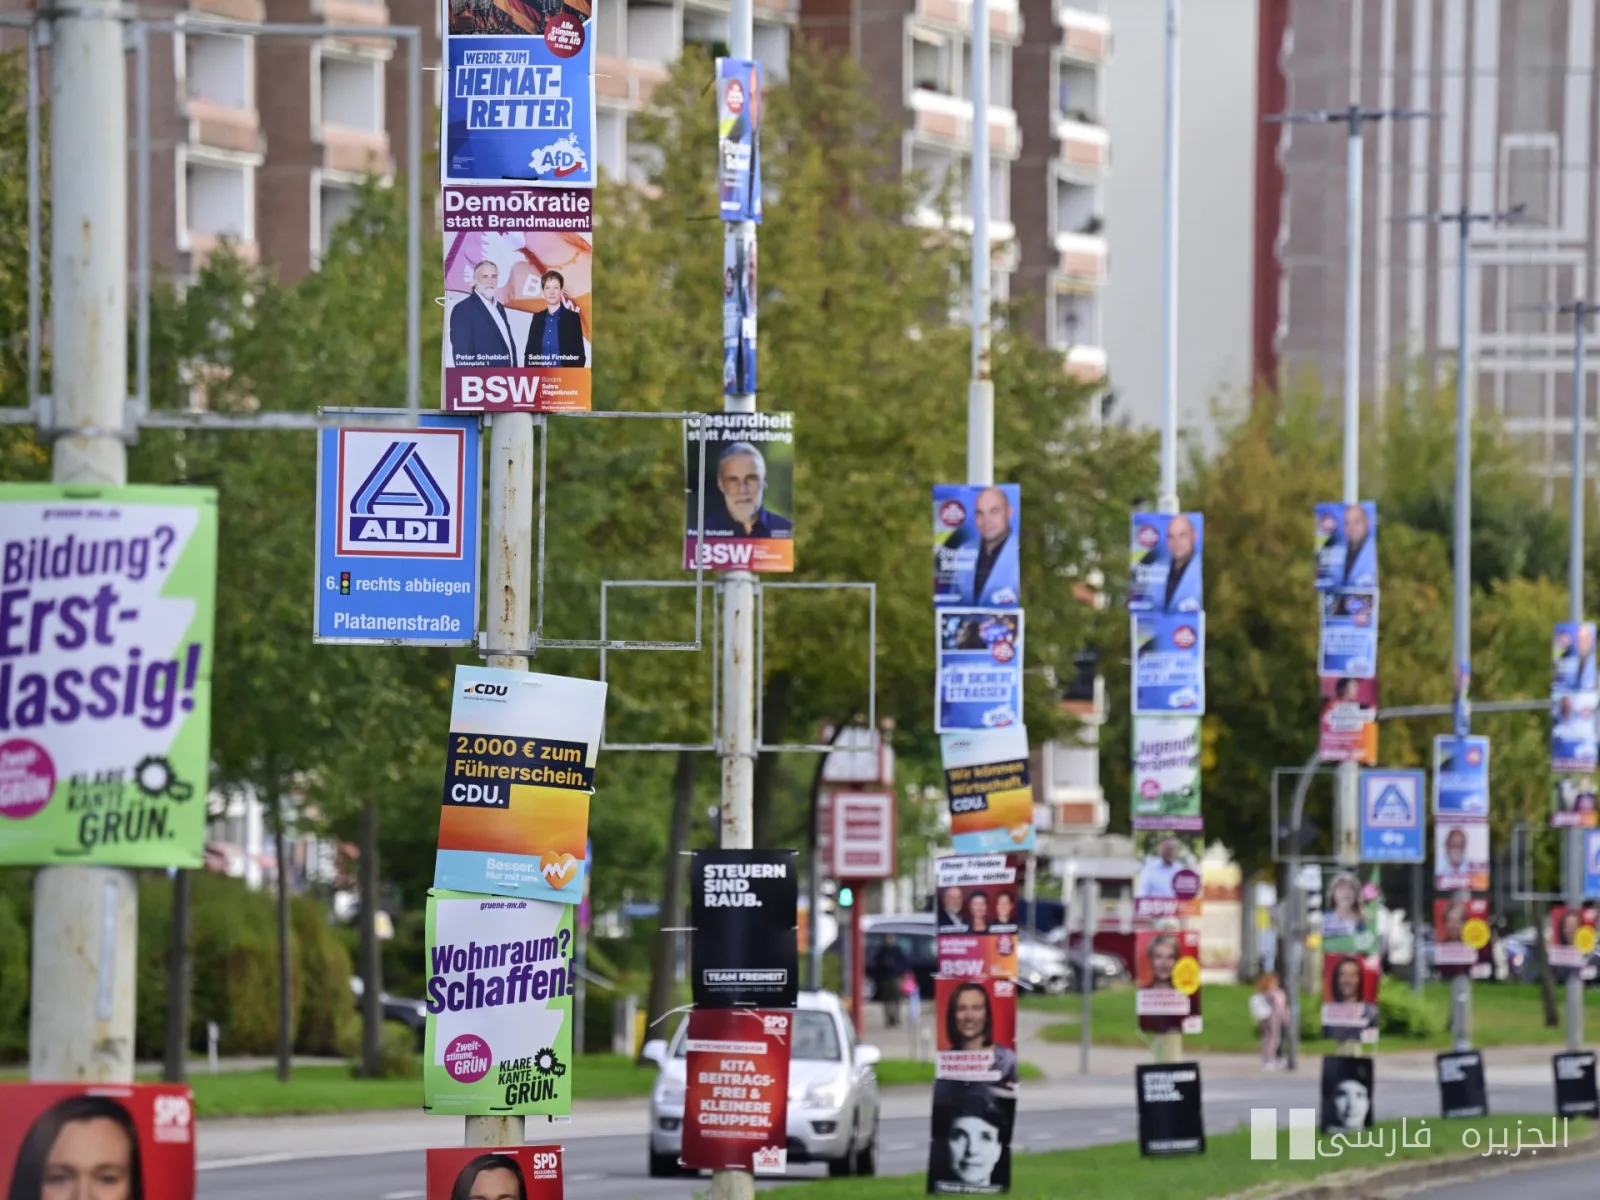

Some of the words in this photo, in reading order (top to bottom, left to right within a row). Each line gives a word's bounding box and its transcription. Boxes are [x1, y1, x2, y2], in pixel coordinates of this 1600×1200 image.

[551, 27, 579, 37] Stimmen
[561, 21, 573, 30] Alle
[558, 35, 569, 43] die
[465, 52, 503, 64] WERDE
[505, 52, 528, 64] ZUM
[456, 67, 561, 96] HEIMAT-
[469, 99, 571, 127] RETTER
[541, 151, 574, 167] AfD
[445, 191, 590, 212] Demokratie
[446, 215, 483, 228] statt
[488, 215, 590, 228] Brandmauern!
[461, 375, 540, 404] BSW
[688, 429, 719, 441] sttt
[722, 429, 793, 444] Aufrüstung
[358, 519, 438, 541] ALDI
[2, 525, 176, 586] Bildung?
[325, 575, 339, 590] 6.
[356, 578, 401, 592] rechts
[405, 578, 471, 595] abbiegen
[0, 584, 139, 659] Erst-
[333, 612, 461, 632] Platanenstraße
[474, 683, 508, 696] CDU
[456, 736, 517, 757] 2.000
[522, 741, 536, 758] €
[541, 746, 581, 763] zum
[454, 759, 588, 786] Führerschein.
[451, 783, 504, 804] CDU.
[79, 804, 175, 847] GRÜN.
[486, 858, 536, 873] Besser.
[704, 864, 787, 878] STEUERN
[486, 871, 503, 880] Nur
[504, 872, 520, 881] mit
[521, 874, 541, 883] uns.
[704, 878, 749, 893] SIND
[480, 902, 527, 911] gruene-mv.de
[704, 892, 763, 907] RAUB.
[431, 928, 571, 976] Wohnraum?
[708, 973, 737, 981] TEAM
[739, 973, 784, 981] FREIHEIT
[426, 957, 573, 1015] Schaffen!
[764, 1015, 788, 1029] SPD
[455, 1041, 481, 1052] Zweit-
[446, 1051, 473, 1062] stimme
[454, 1056, 488, 1075] GRÜN
[500, 1057, 532, 1072] KLARE
[720, 1060, 756, 1072] KITA
[498, 1070, 532, 1085] KANTE
[698, 1072, 775, 1086] BEITRAGS-
[505, 1076, 558, 1106] GRÜN.
[713, 1086, 747, 1099] FREI
[750, 1088, 761, 1099] &
[700, 1100, 771, 1113] KLEINERE
[698, 1112, 773, 1127] GRUPPEN.
[533, 1152, 558, 1169] SPD
